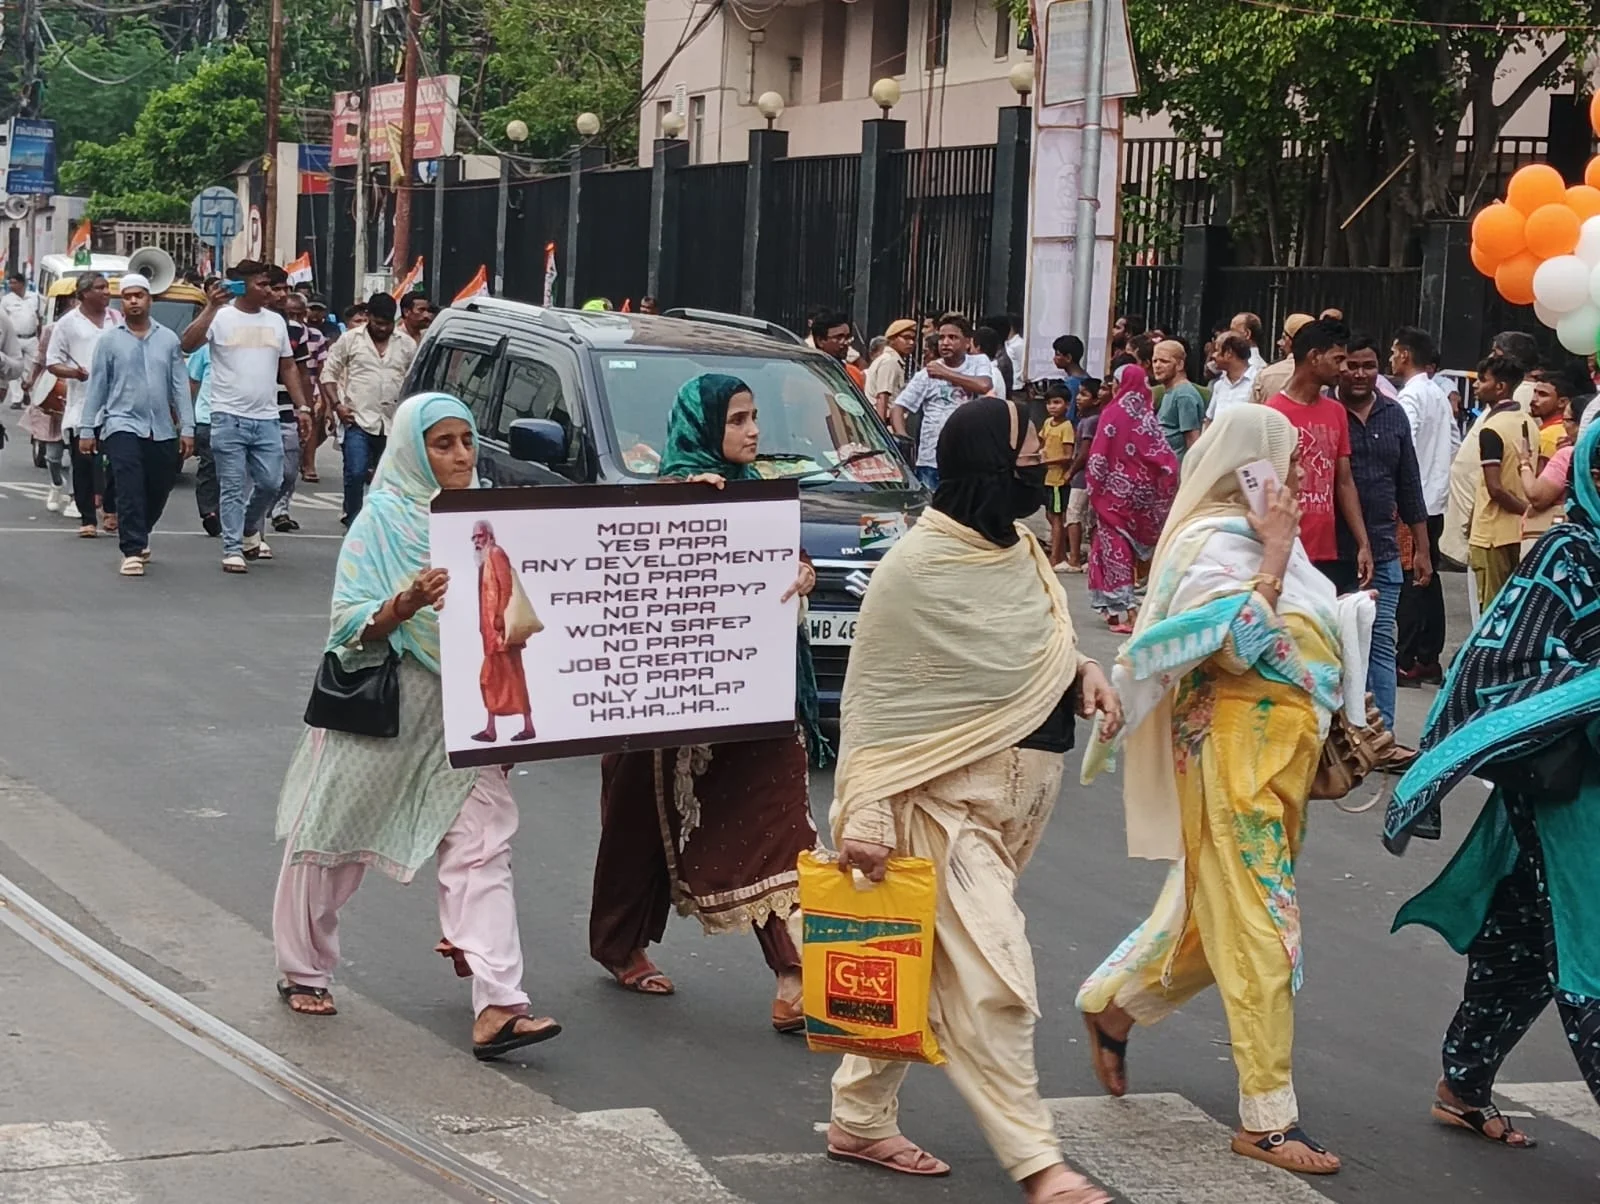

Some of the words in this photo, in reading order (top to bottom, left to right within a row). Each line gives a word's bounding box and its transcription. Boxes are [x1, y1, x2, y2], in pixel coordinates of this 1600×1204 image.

[597, 521, 661, 536] MODI
[667, 518, 728, 534] MODI
[598, 538, 650, 553] YES
[658, 535, 728, 551] PAPA
[521, 558, 577, 574] ANY
[585, 548, 794, 571] DEVELOPMENT?
[603, 572, 640, 586] NO
[648, 568, 717, 584] PAPA
[550, 587, 658, 606] FARMER
[666, 582, 767, 600] HAPPY?
[603, 605, 639, 620] NO
[646, 601, 716, 618] PAPA
[565, 620, 663, 639] WOMEN
[670, 615, 752, 633] SAFE?
[811, 619, 831, 639] WB
[603, 638, 638, 653] NO
[646, 633, 715, 651] PAPA
[559, 657, 611, 674] JOB
[619, 647, 758, 669] CREATION?
[604, 672, 638, 687] NO
[646, 666, 714, 684] PAPA
[573, 688, 637, 707] ONLY
[644, 680, 745, 700] JUMLA?
